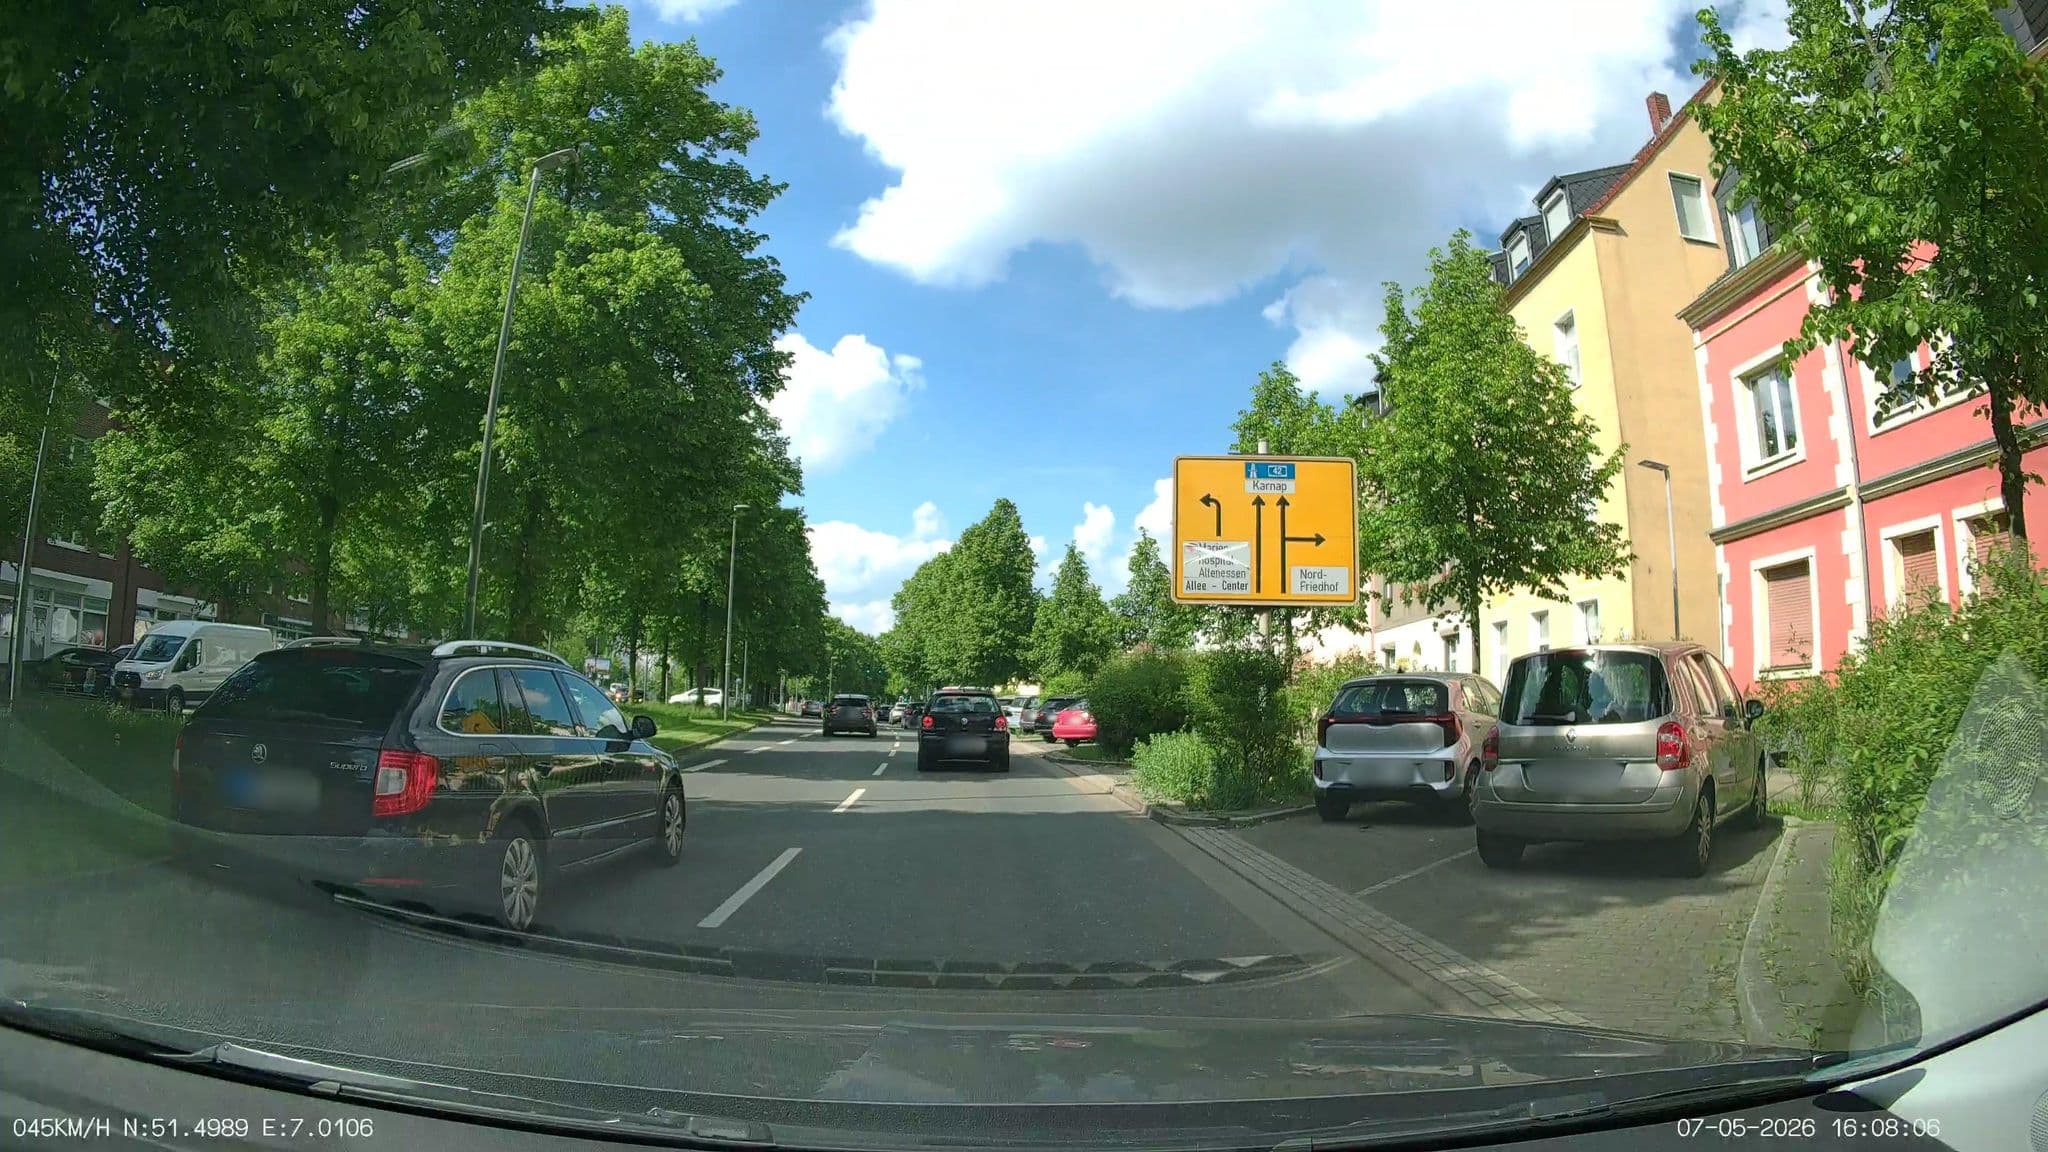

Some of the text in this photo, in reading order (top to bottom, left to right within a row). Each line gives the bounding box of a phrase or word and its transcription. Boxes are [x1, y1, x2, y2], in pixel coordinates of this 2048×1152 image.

[1272, 466, 1283, 475] 42
[1252, 480, 1287, 493] Karnap
[1199, 567, 1246, 578] Altenessen
[1300, 569, 1327, 579] Nord-
[1185, 580, 1207, 591] Allee
[1222, 580, 1249, 591] Center
[1300, 580, 1339, 592] Friedhof
